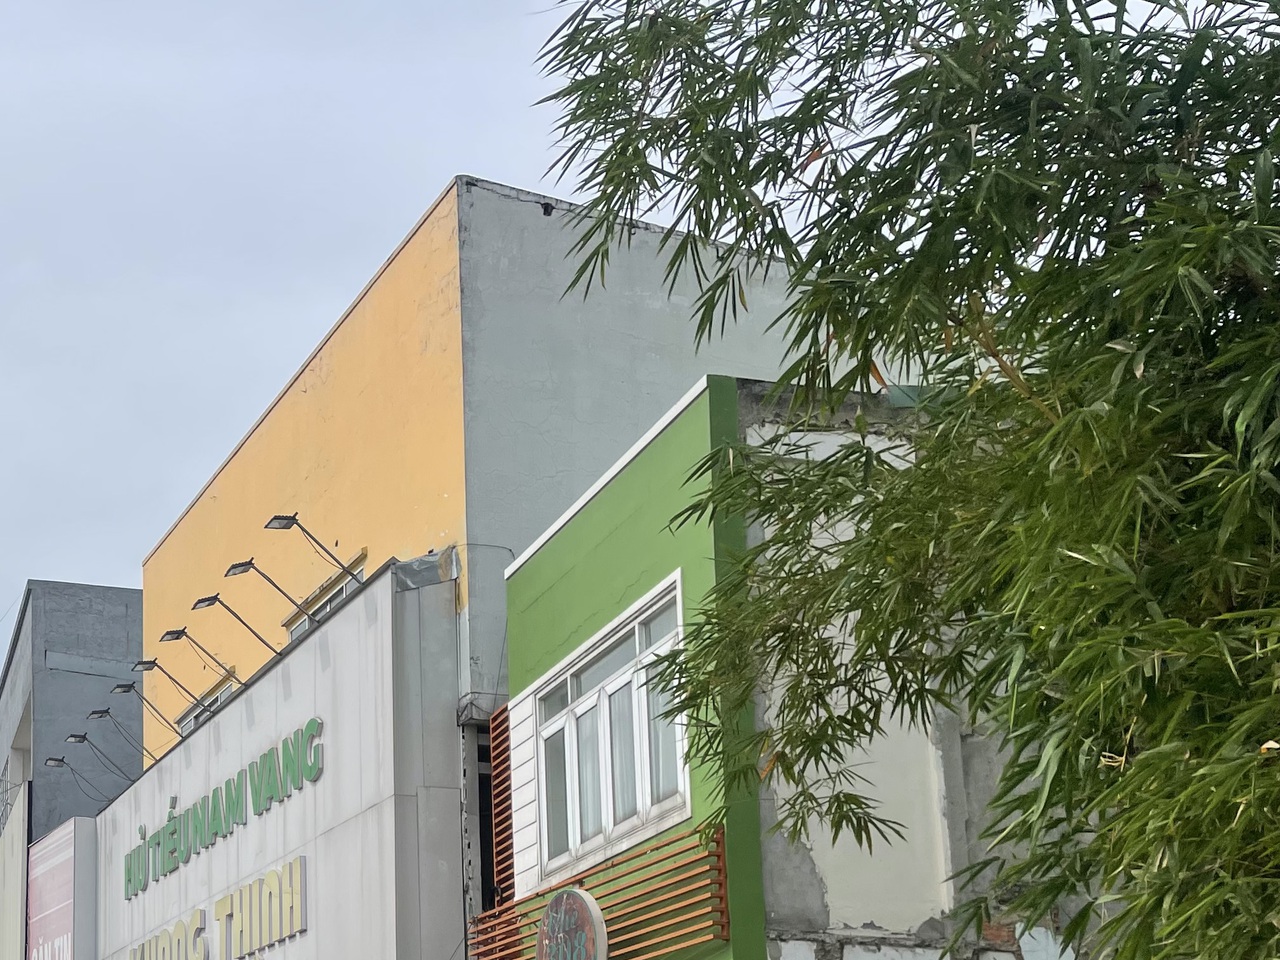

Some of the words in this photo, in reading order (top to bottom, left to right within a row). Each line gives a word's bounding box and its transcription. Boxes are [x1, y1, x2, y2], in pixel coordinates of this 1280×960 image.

[125, 824, 150, 900] HỦ
[149, 796, 191, 882] TIẾU
[193, 769, 247, 855] NAM
[248, 717, 324, 816] VANG
